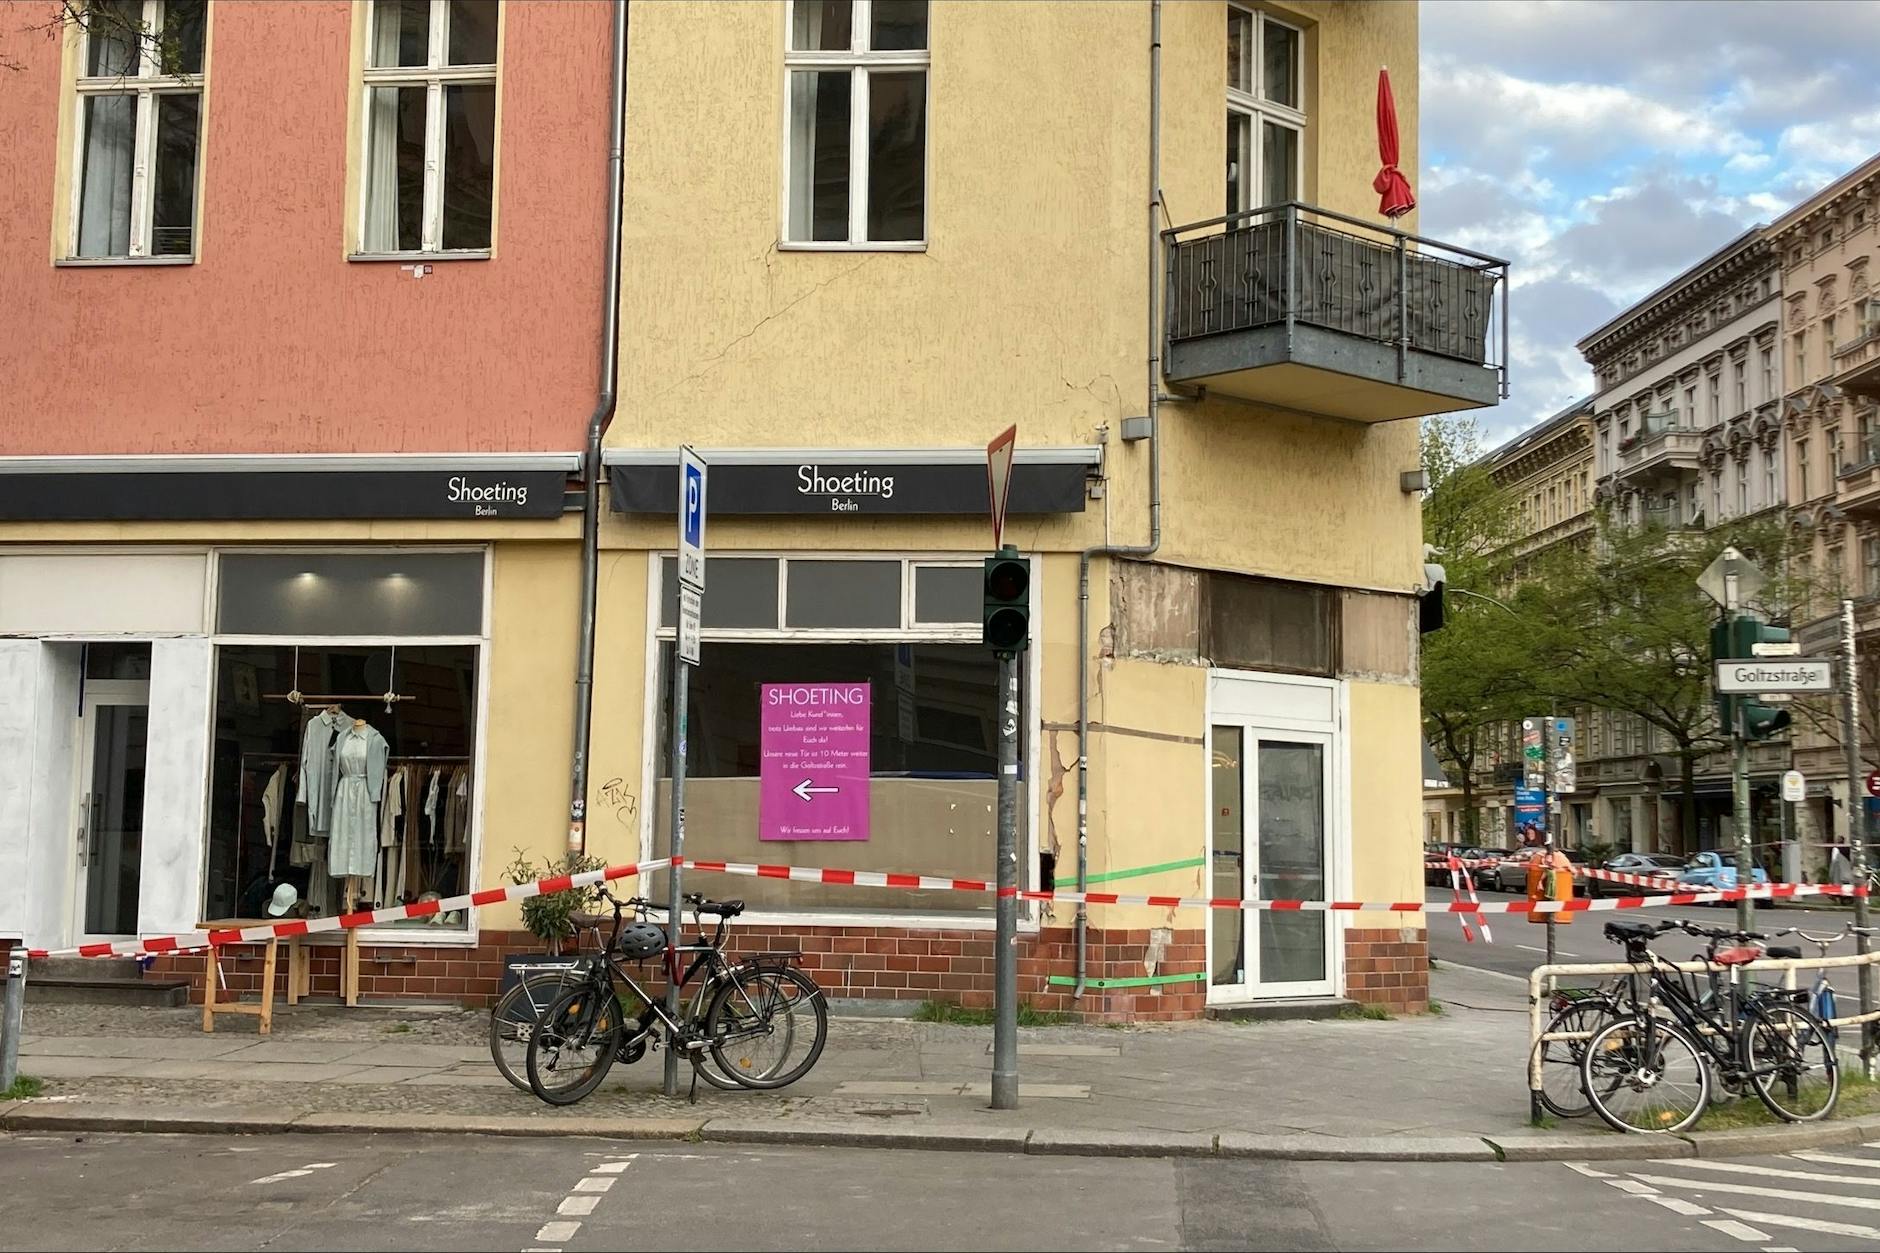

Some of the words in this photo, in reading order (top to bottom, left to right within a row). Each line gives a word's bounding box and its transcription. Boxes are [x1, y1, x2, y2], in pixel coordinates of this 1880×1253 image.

[797, 464, 895, 499] Shoeting
[447, 476, 528, 505] Shoeting
[474, 505, 498, 517] Berlin
[831, 498, 860, 512] Berlin
[1734, 666, 1818, 685] Goltzstraße
[768, 687, 864, 705] SHOETING
[803, 736, 817, 744] Euch
[800, 749, 809, 757] Tür
[830, 749, 849, 757] Meter
[789, 761, 799, 769] die
[779, 826, 791, 834] Wir
